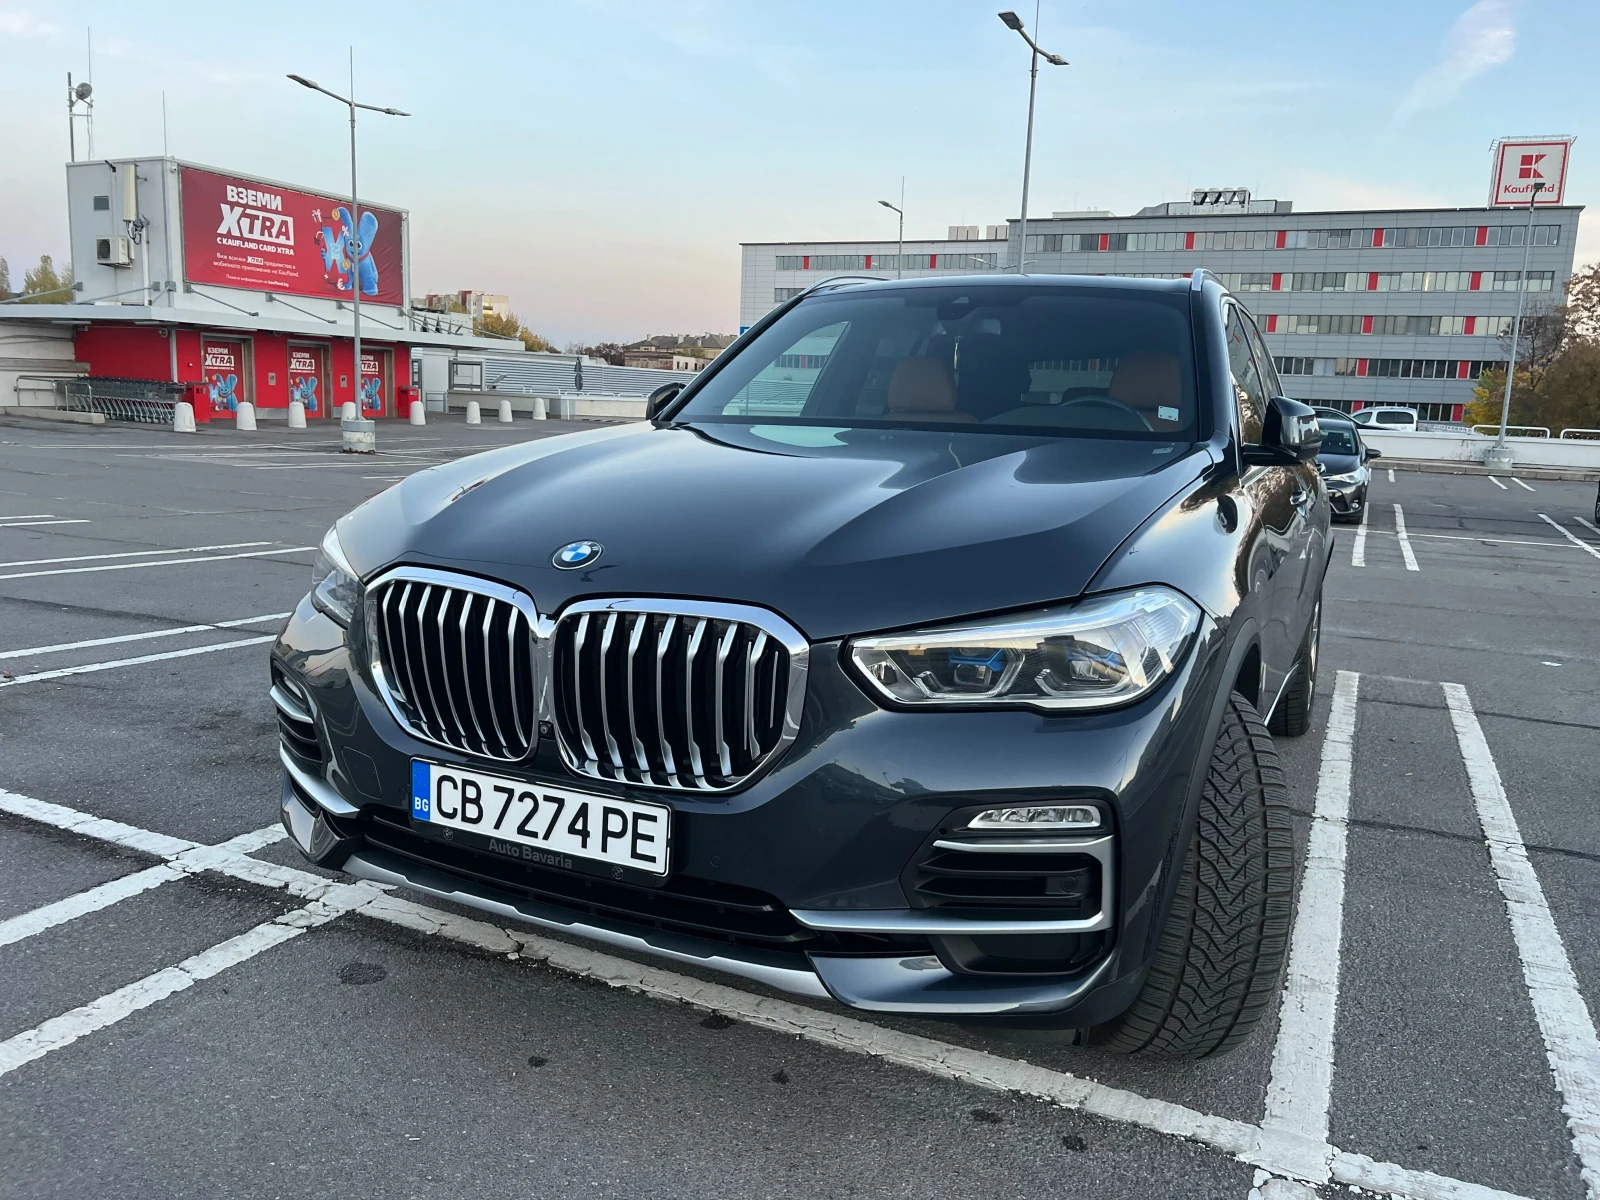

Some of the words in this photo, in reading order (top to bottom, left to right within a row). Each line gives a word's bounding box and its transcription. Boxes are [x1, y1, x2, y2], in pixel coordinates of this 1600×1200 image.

[226, 185, 282, 211] ВЗЕМИ
[1504, 184, 1554, 193] Kauflnd
[217, 203, 294, 246] XTRA
[223, 238, 258, 250] KAUFLAND
[259, 244, 276, 252] CARD
[277, 246, 295, 256] XTRA
[414, 796, 429, 812] BG
[488, 838, 520, 857] Auto
[521, 845, 573, 869] Bavaria
